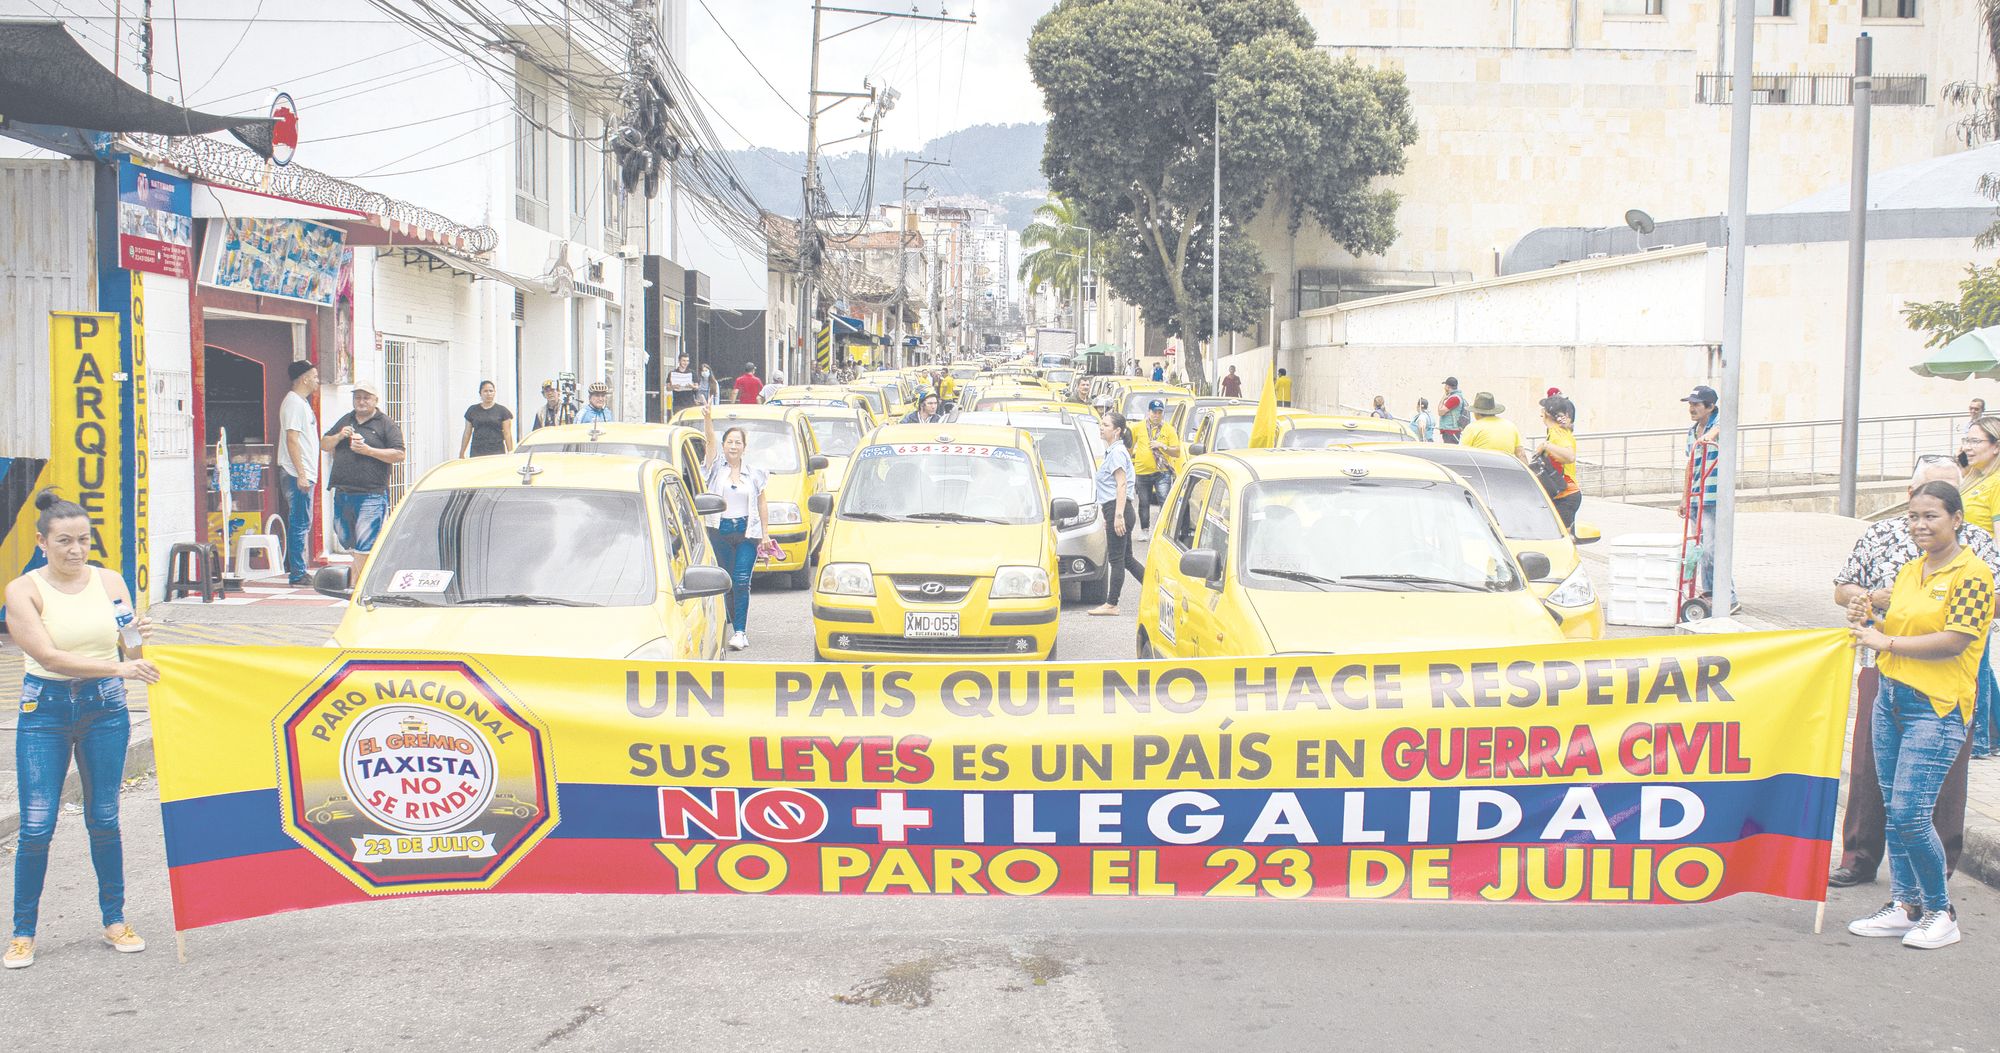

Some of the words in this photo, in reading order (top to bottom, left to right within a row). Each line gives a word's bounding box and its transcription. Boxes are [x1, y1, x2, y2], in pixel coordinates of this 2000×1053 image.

[73, 318, 109, 568] PARQUEA
[898, 445, 989, 456] 634-2222
[625, 670, 725, 718] UN
[775, 664, 916, 718] PAÍS
[940, 670, 1075, 718] QUE
[1102, 668, 1208, 713] NO
[1233, 664, 1403, 712] HACE
[1428, 656, 1735, 709] RESPETAR
[311, 690, 367, 743] PARO
[374, 679, 514, 745] NACIONAL
[357, 756, 481, 780] TAXISTA
[358, 738, 382, 757] EL
[385, 733, 475, 756] GREMIO
[628, 742, 730, 778] SUS
[749, 734, 935, 784] LEYES
[952, 743, 1010, 781] ES
[1031, 743, 1112, 782] UN
[1132, 716, 1272, 780] PAÍS
[1295, 739, 1365, 778] EN
[1381, 724, 1603, 781] GUERRA
[1618, 721, 1751, 776] CIVIL
[367, 788, 399, 815] SE
[405, 780, 479, 820] RINDE
[401, 777, 441, 795] NO
[963, 785, 1706, 844] ILEGALIDAD
[364, 837, 392, 856] 23
[397, 836, 424, 853] DE
[428, 835, 485, 853] JULIO
[653, 842, 789, 893] YO
[819, 845, 1060, 896] PARO
[1090, 848, 1178, 896] EL
[1203, 847, 1315, 899] 23
[1346, 847, 1451, 899] DE
[1478, 845, 1726, 902] JULIO
